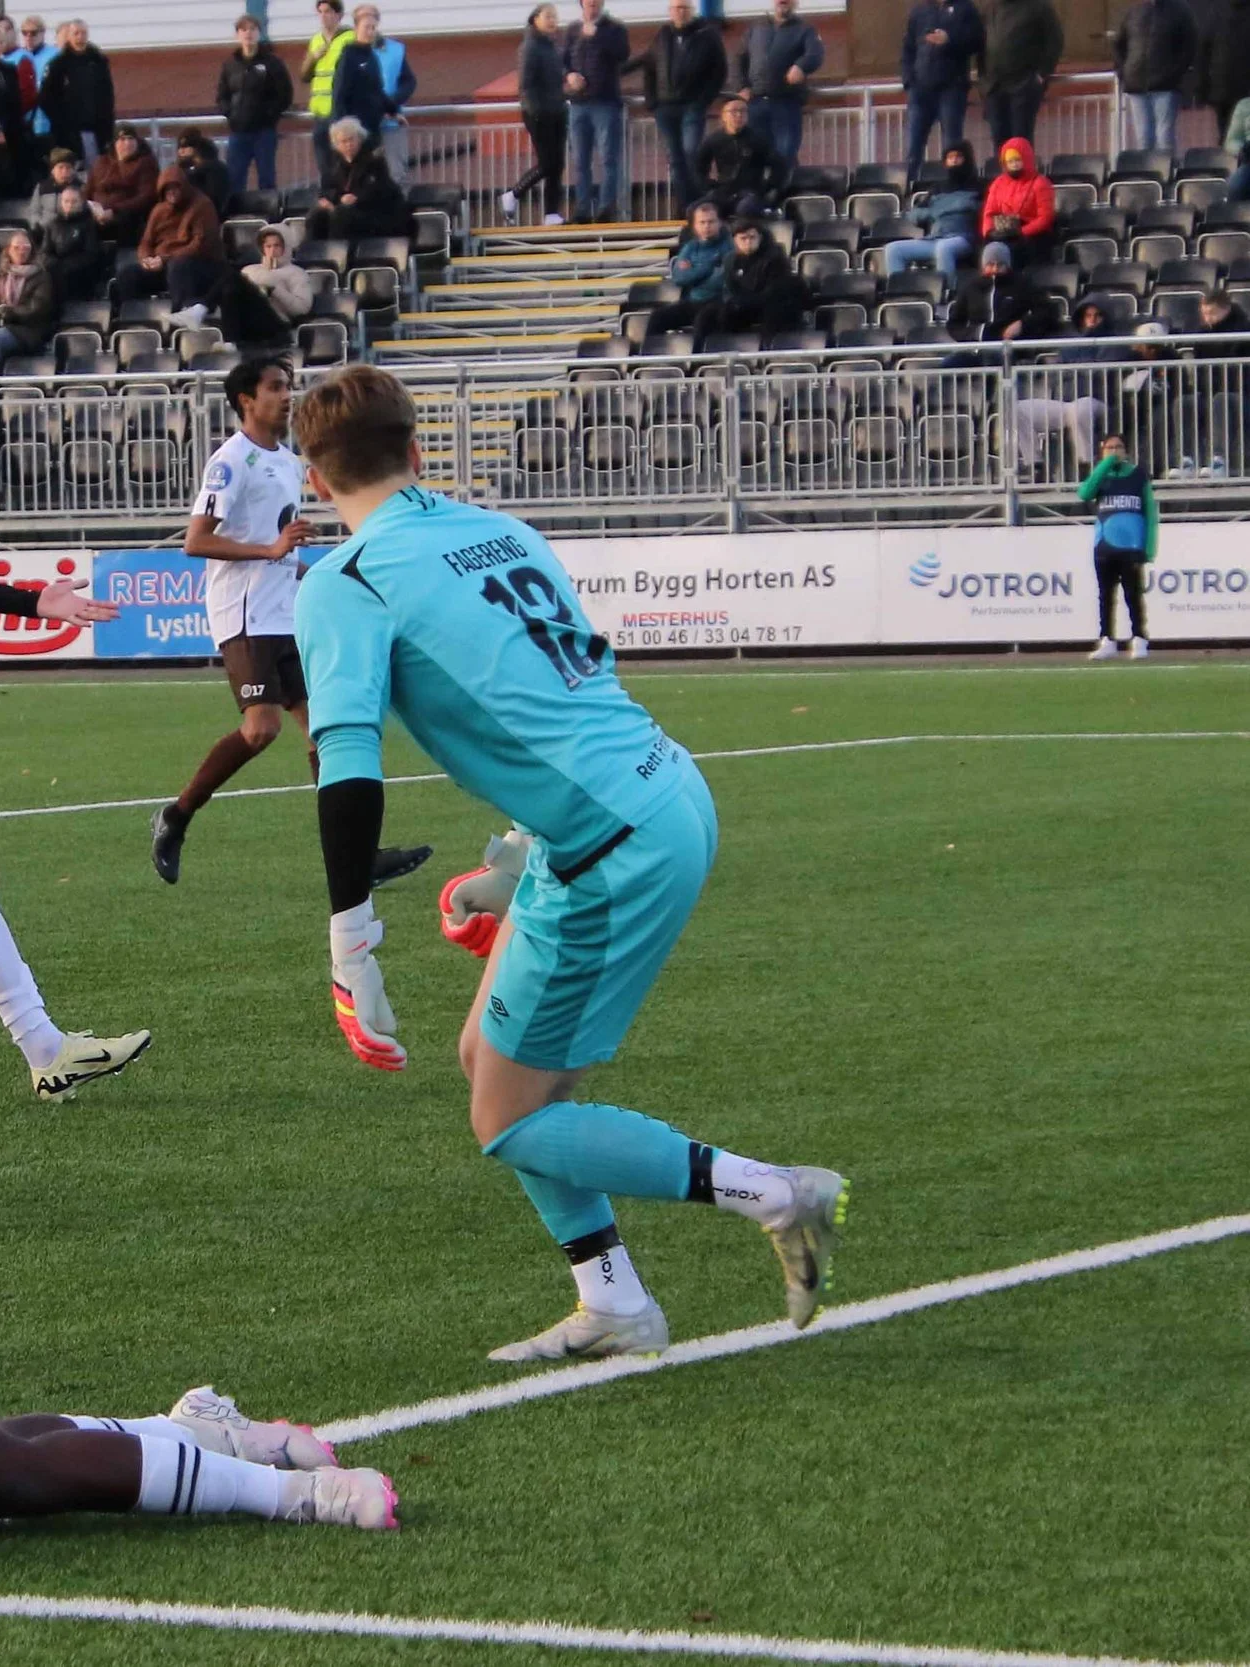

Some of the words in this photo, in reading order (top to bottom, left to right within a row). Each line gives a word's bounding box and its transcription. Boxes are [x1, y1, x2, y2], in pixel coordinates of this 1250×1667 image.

[442, 535, 528, 577] FAGERENG
[634, 570, 697, 597] Bygg
[706, 567, 794, 590] Horten
[803, 565, 836, 588] AS
[938, 572, 1073, 598] JOTRON
[1143, 567, 1249, 595] JOTRO
[622, 611, 729, 627] MESTERHUS
[971, 605, 1034, 616] Performance
[479, 566, 609, 692] 12
[617, 631, 634, 646] 51
[643, 630, 662, 645] 00
[668, 629, 688, 645] 46
[704, 628, 725, 643] 33
[730, 627, 750, 643] 04
[756, 626, 776, 641] 78
[783, 626, 802, 641] 17
[636, 751, 662, 781] Rett
